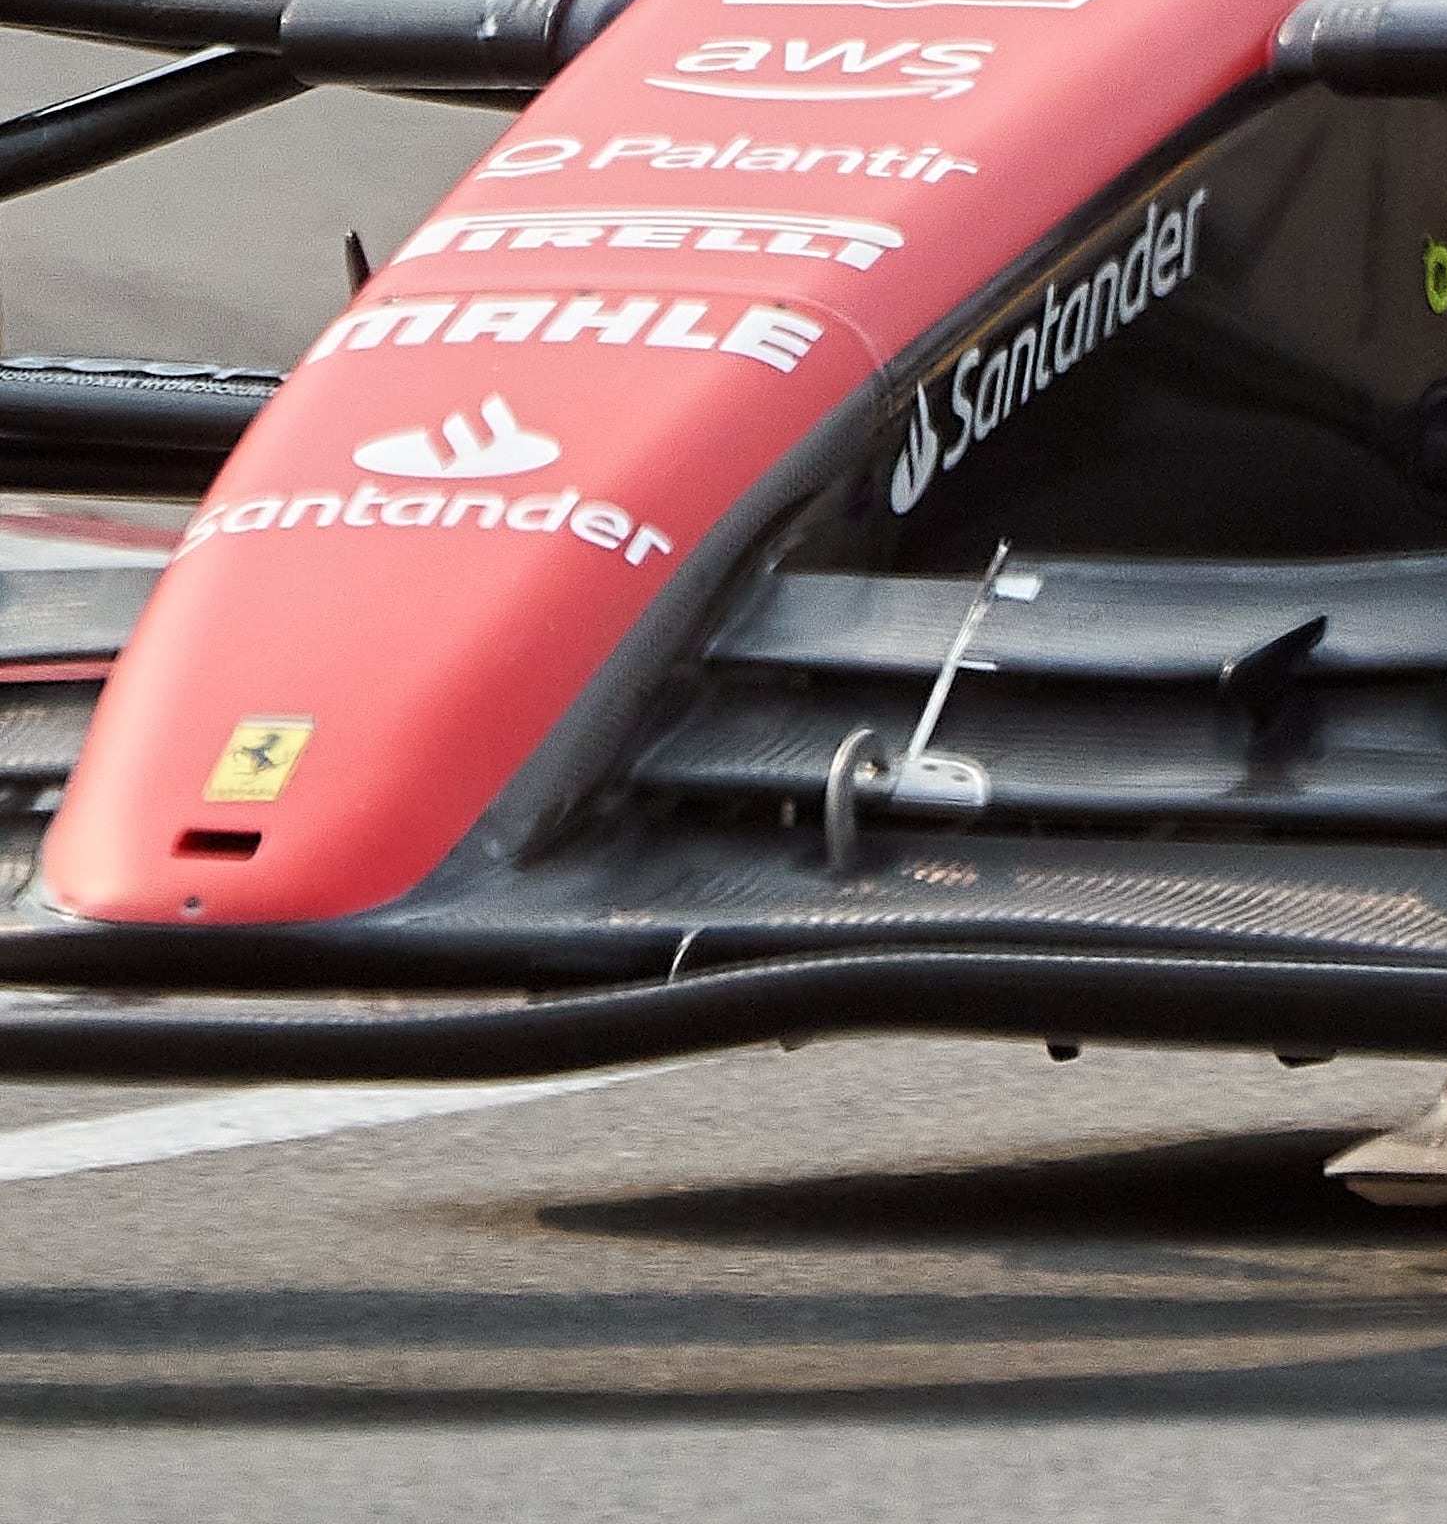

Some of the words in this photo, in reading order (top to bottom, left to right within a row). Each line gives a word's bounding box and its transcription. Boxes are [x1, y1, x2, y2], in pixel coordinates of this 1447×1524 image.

[675, 38, 995, 75] aws
[588, 134, 978, 184] Palantir
[390, 208, 905, 271] PIRELLI
[304, 296, 824, 374] MAHLE
[942, 188, 1208, 471] Santander
